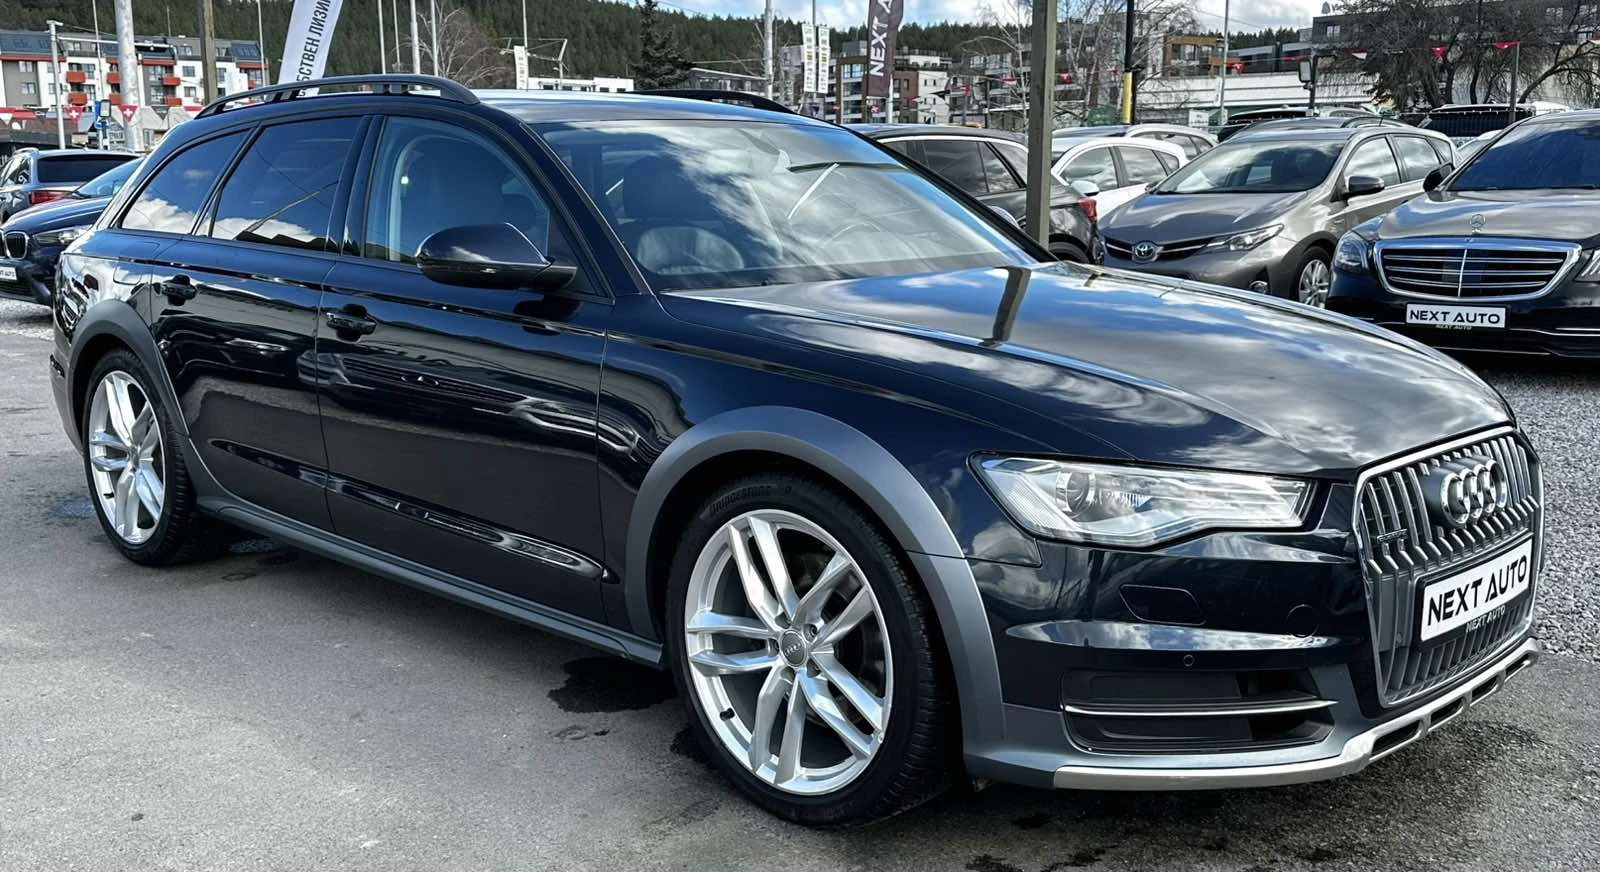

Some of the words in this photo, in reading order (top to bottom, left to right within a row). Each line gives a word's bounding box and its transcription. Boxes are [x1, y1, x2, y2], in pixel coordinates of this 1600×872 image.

[308, 0, 331, 37] ЛИЗИ
[869, 16, 888, 77] NEXT
[1410, 310, 1450, 322] NEXT
[1453, 312, 1501, 324] AUTO
[1427, 577, 1484, 626] NEXT
[1485, 555, 1527, 603] AUTO
[1465, 614, 1488, 633] NEXT
[1486, 605, 1506, 623] AUTO
